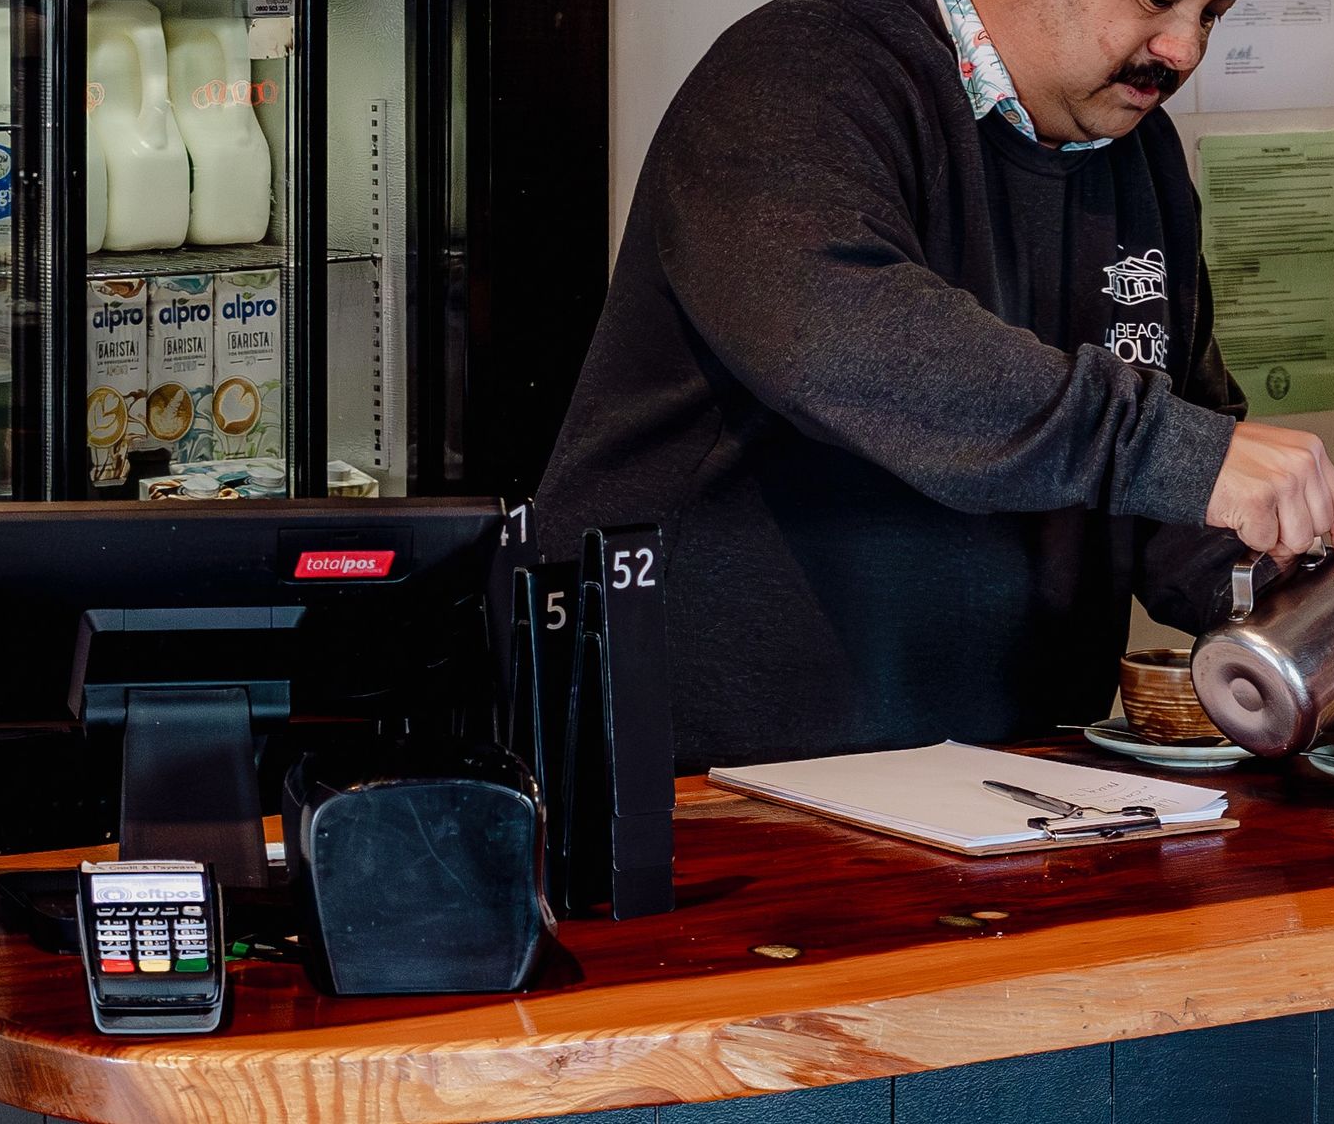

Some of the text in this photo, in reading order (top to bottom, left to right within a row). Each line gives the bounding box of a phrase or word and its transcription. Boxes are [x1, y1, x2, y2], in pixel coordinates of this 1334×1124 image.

[92, 302, 144, 334] alpro
[158, 298, 211, 330] alpro
[221, 292, 278, 325] alpro
[230, 332, 271, 350] BARISTA
[1115, 323, 1166, 340] BEACH
[98, 341, 137, 360] BARISTA
[166, 336, 204, 356] BARISTA
[306, 554, 376, 573] totalpos
[611, 548, 656, 589] 52
[135, 886, 201, 901] eftpos
